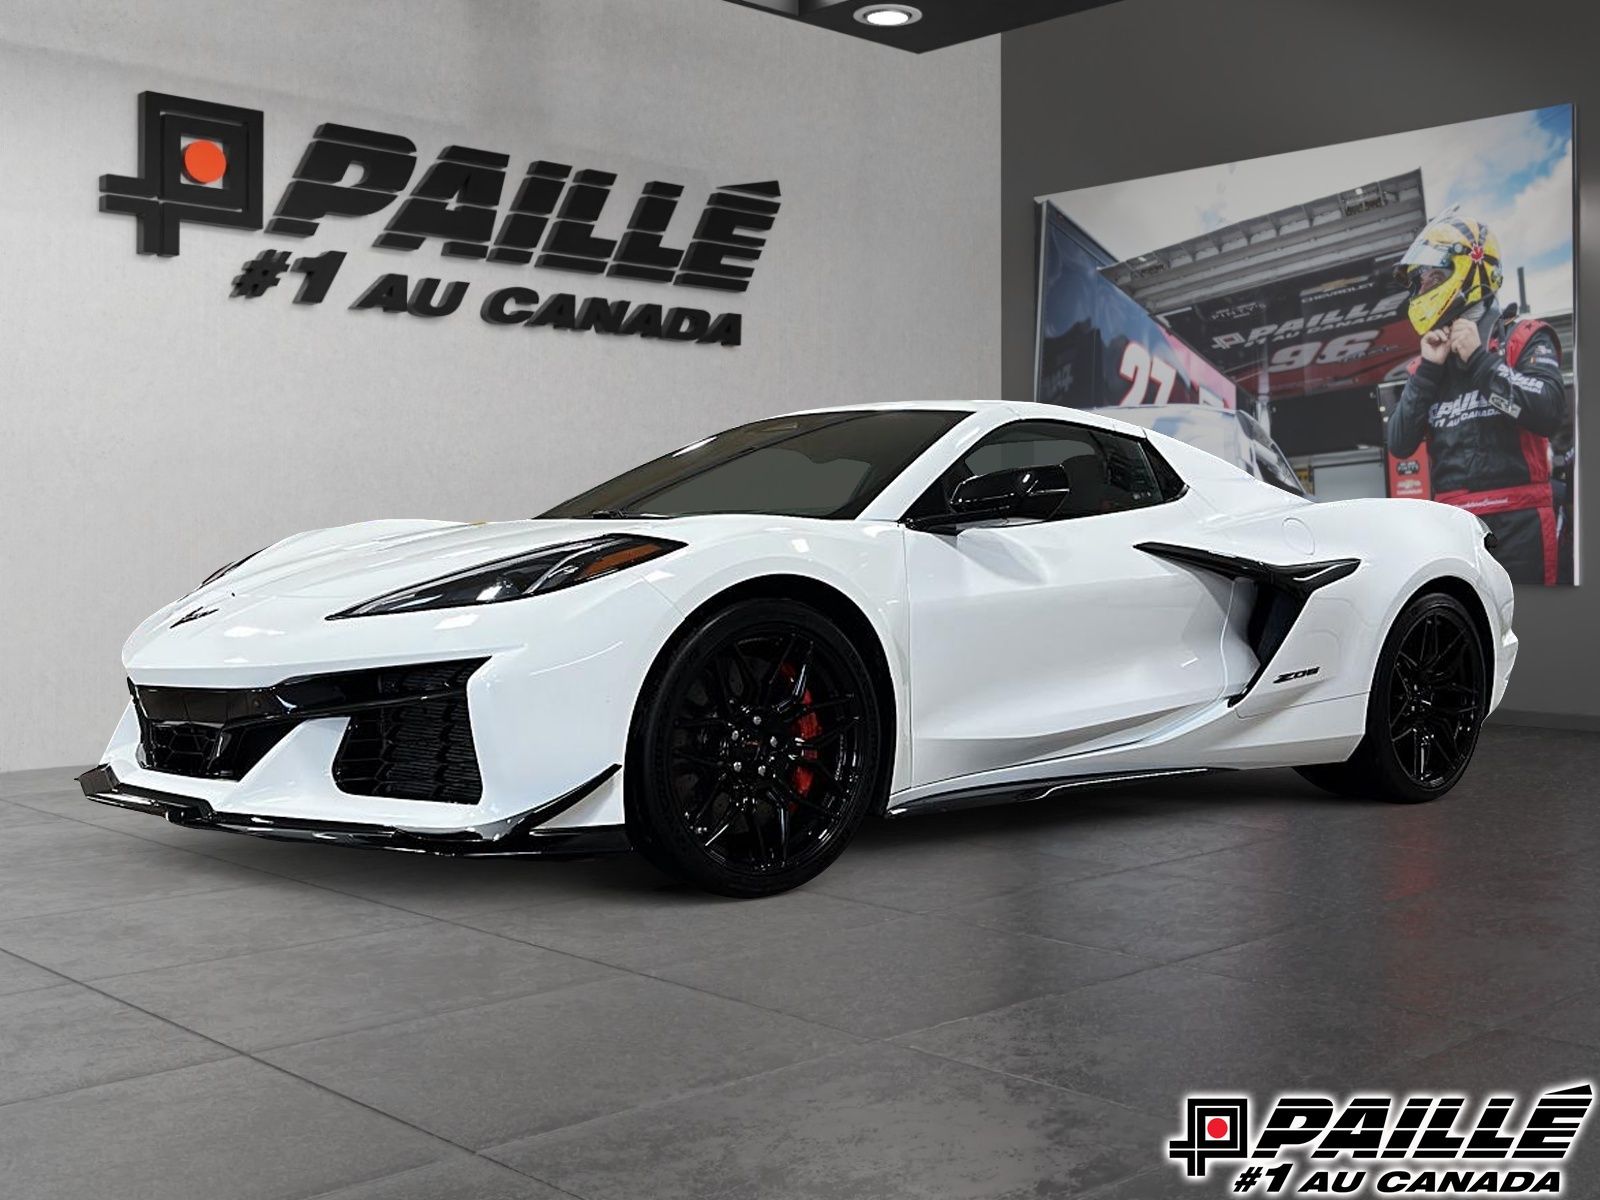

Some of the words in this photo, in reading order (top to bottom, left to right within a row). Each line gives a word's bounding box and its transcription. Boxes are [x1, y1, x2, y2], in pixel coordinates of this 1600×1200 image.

[264, 121, 781, 292] PAILLÉ
[229, 249, 347, 305] #1
[348, 273, 470, 317] AU
[480, 286, 743, 347] CANADA
[1306, 311, 1398, 335] CANADA
[1119, 340, 1176, 407] 27
[1268, 330, 1380, 374] 96
